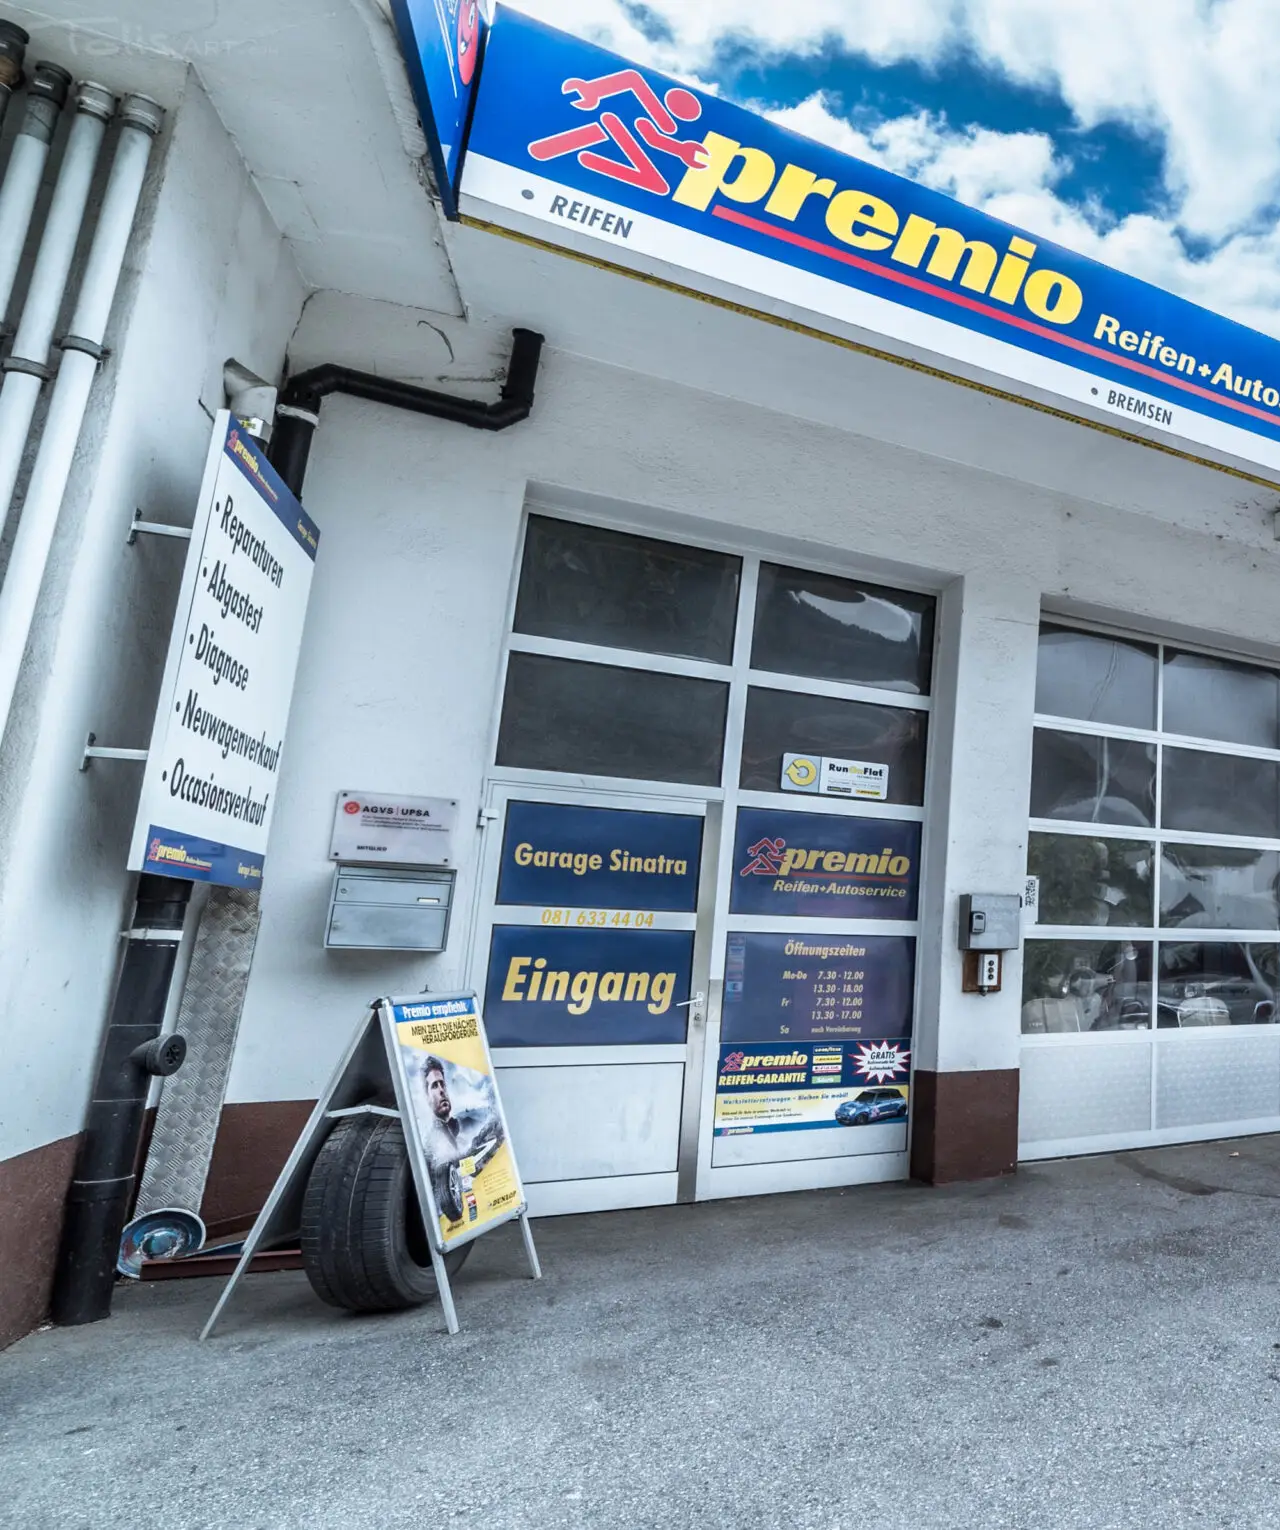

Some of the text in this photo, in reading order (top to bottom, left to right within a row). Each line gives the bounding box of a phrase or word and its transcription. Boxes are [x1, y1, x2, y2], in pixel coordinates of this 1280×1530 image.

[549, 194, 634, 239] REIFEN
[672, 131, 1083, 325] premio
[1107, 389, 1173, 426] BREMSEN
[220, 495, 284, 588] Reparaturen
[207, 560, 264, 634] Abgastest
[195, 623, 249, 691] Diagnose
[181, 689, 282, 773] Neuwagenverkauf
[170, 758, 269, 826] Occasionsverkauf
[363, 806, 430, 817] AGVS UPSA
[514, 843, 688, 875] Garage Sinatra
[778, 848, 910, 876] premio
[773, 880, 907, 898] Reifen+Autoservice
[541, 909, 654, 928] 081 633 44 04
[784, 939, 866, 959] Öffnungszeiten
[782, 970, 808, 980] Mo-Do
[817, 970, 837, 980] 7.30
[843, 970, 864, 980] 12.00
[502, 956, 677, 1016] Eingang
[813, 984, 836, 993] 13.30
[842, 983, 864, 993] 18.00
[402, 1001, 468, 1019] Premio empfiehlt
[781, 997, 790, 1007] Fr
[816, 997, 836, 1007] 7.30
[842, 997, 863, 1007] 12.00
[811, 1011, 835, 1020] 13.30
[841, 1010, 862, 1019] 17.00
[411, 1024, 427, 1036] MEIN
[442, 1022, 453, 1032] DIE
[780, 1025, 790, 1034] Sa
[739, 1051, 808, 1071] premio
[870, 1051, 895, 1060] GRATIS
[718, 1072, 807, 1086] REIFEN-GARANTIE
[492, 1190, 517, 1206] DUNLOP
